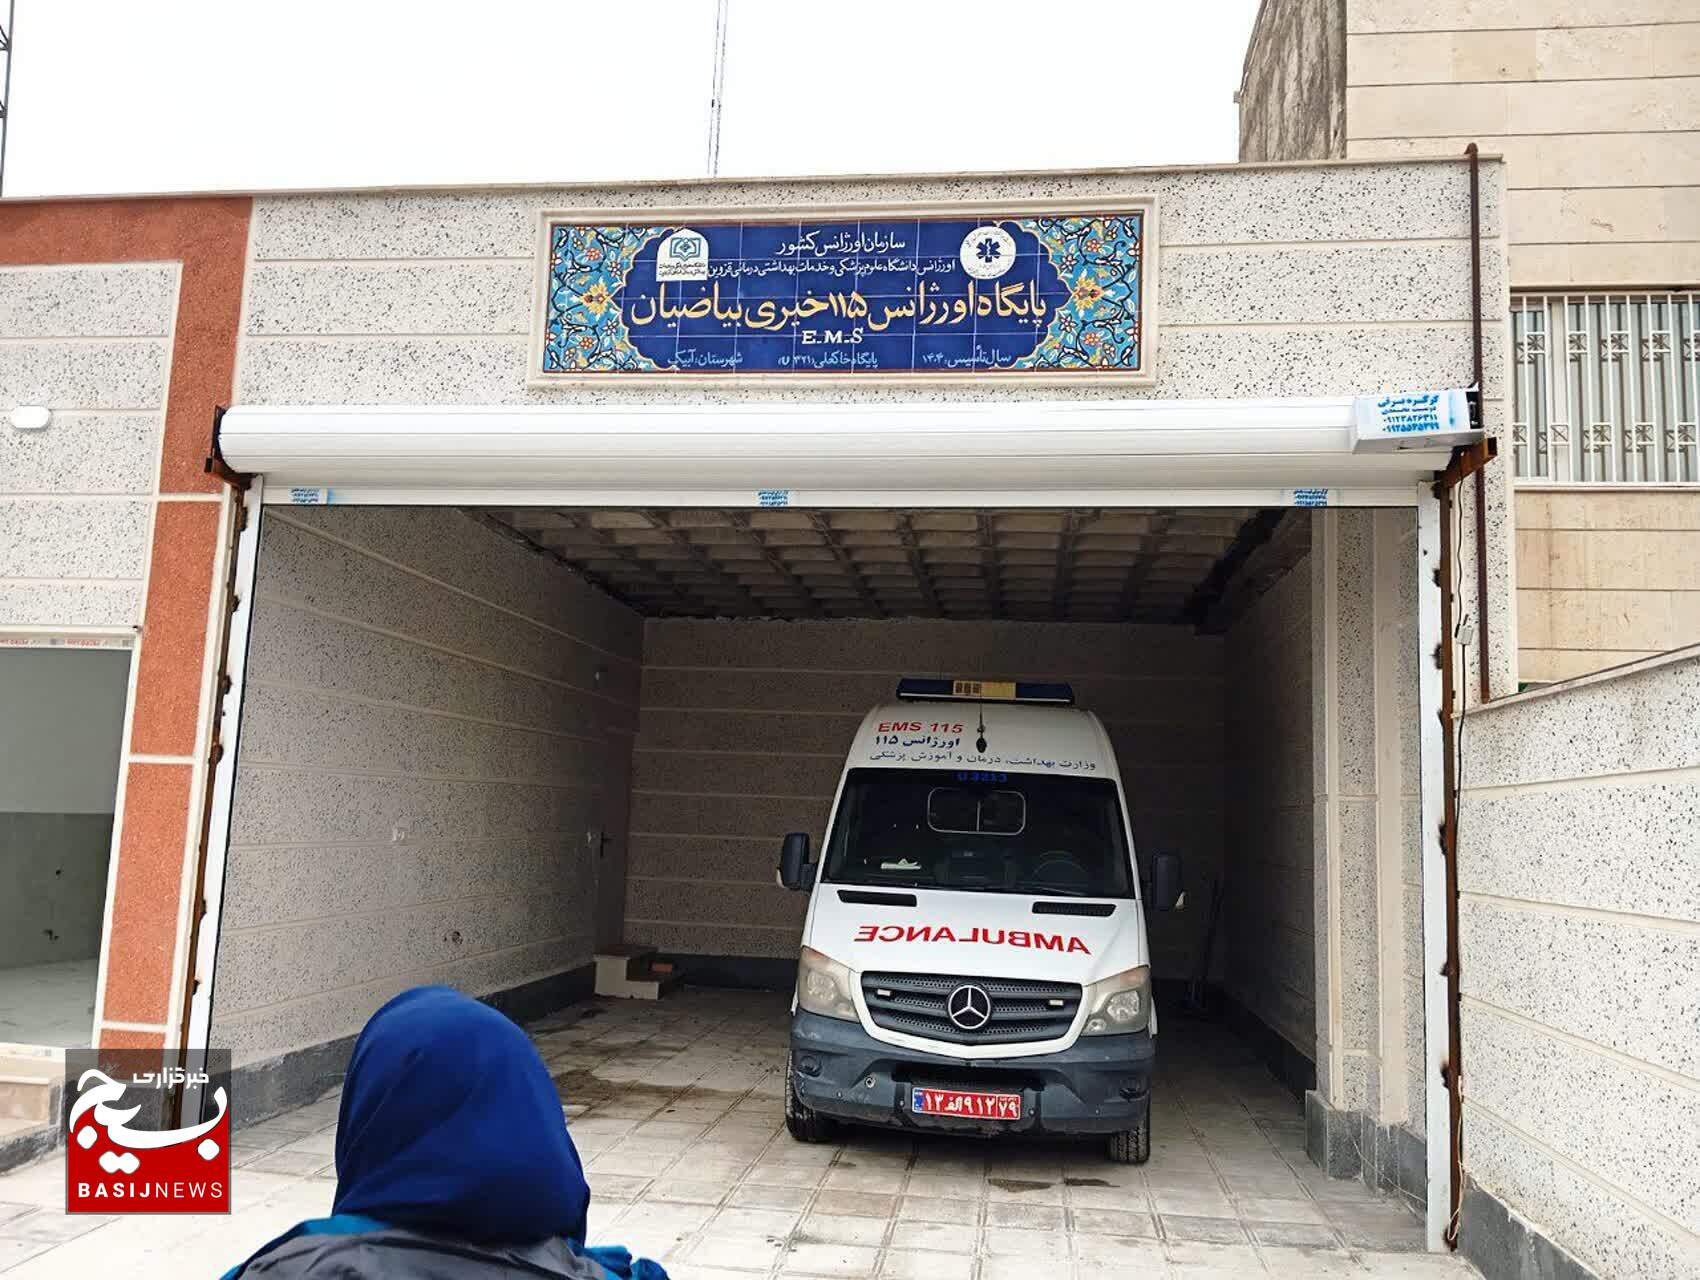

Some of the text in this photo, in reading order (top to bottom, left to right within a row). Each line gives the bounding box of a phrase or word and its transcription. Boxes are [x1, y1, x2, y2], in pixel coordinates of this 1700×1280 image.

[776, 230, 905, 256] سازمان اورژانس کشور
[708, 261, 732, 279] قزوین
[730, 261, 759, 277] درمانی
[758, 259, 796, 276] بهداشتی
[834, 256, 866, 277] پزشکی
[882, 256, 916, 272] دانشگاه
[916, 257, 956, 276] اورژانس
[631, 279, 1047, 332] پایگاه اورژانس ۱۱۵ خیری بیاضیان
[851, 350, 878, 368] پایگاه
[986, 348, 1012, 365] سال
[878, 721, 963, 733] EMS 115
[876, 735, 960, 749] اورژانس ۱۱۵
[869, 750, 906, 762] پزشکی
[911, 751, 952, 763] آموزش
[966, 754, 1001, 765] درمان
[1059, 760, 1096, 771] وزارت
